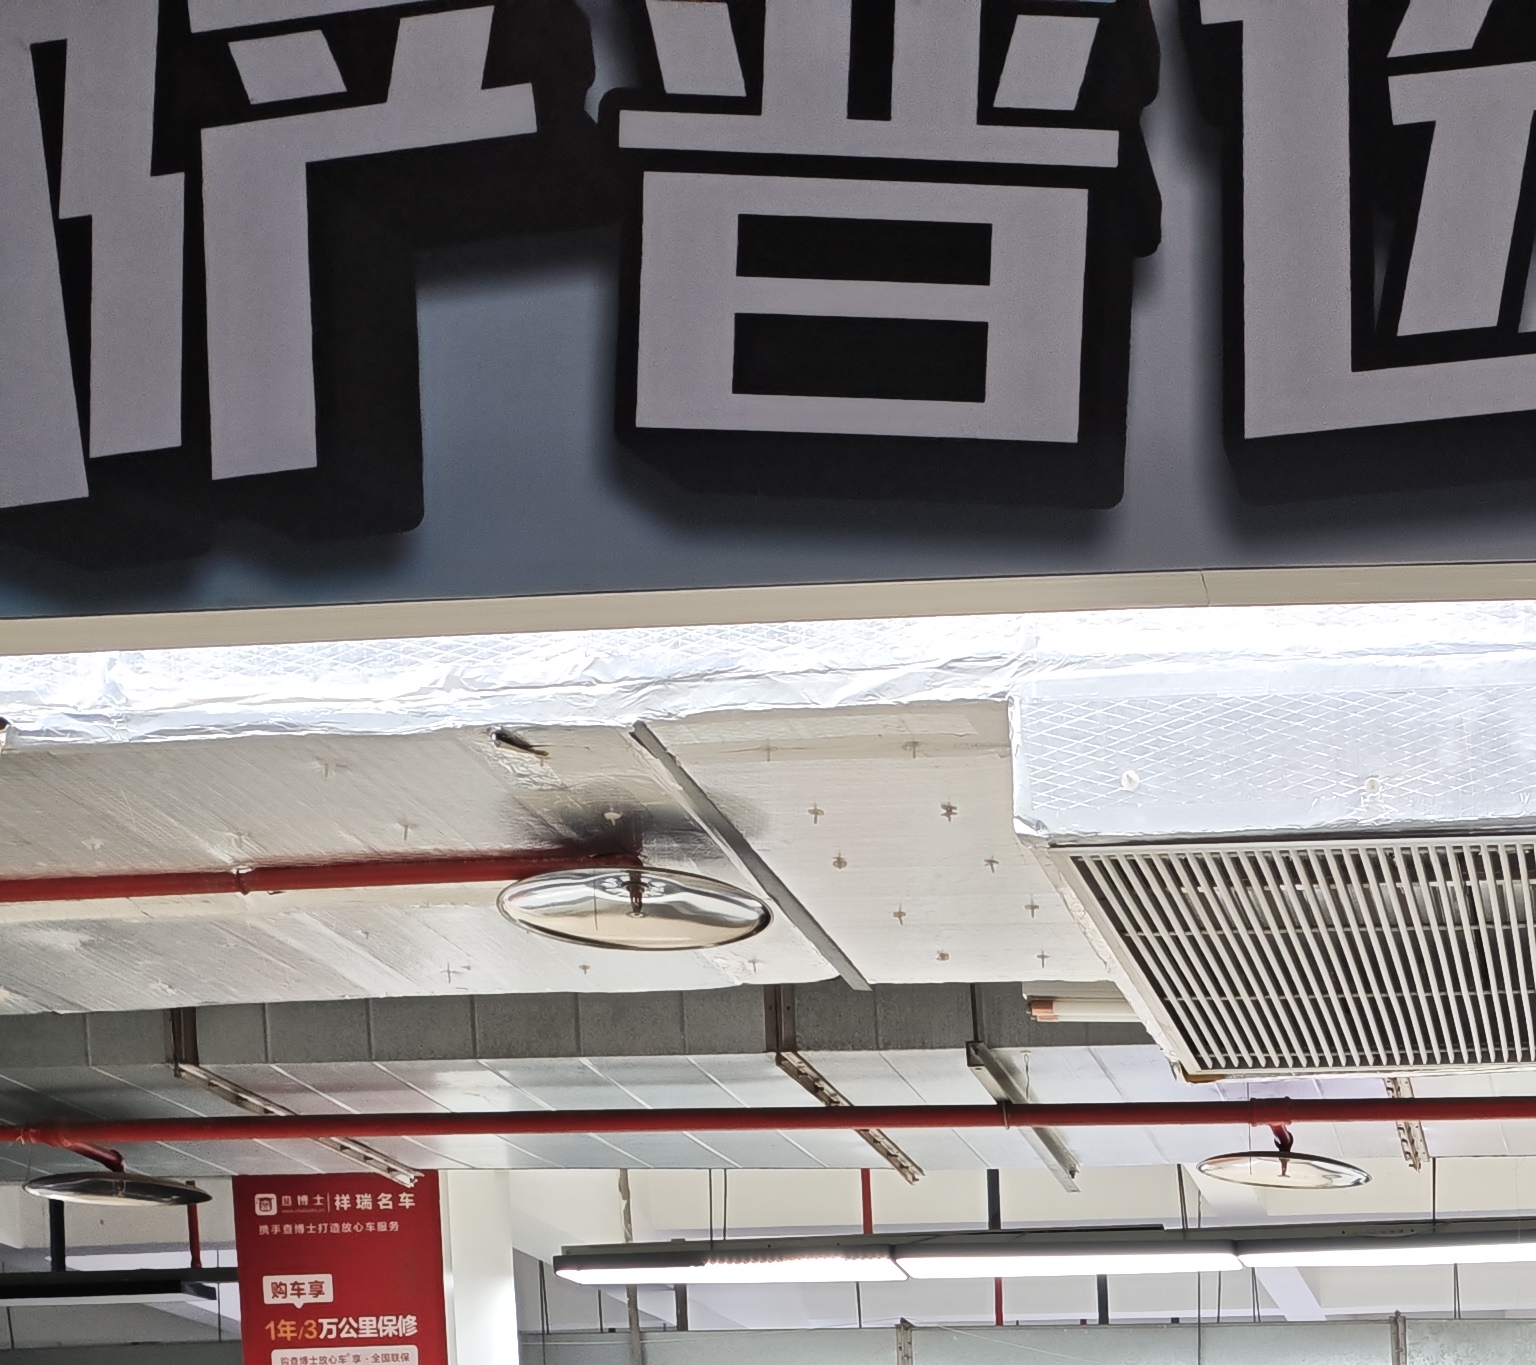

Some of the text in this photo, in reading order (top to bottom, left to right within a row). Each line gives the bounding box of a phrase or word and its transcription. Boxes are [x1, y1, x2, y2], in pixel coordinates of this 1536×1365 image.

[334, 1192, 416, 1211] 祥瑞名车
[258, 1221, 400, 1236] 携手查博士打造放心车服务
[270, 1280, 326, 1299] 购车享
[264, 1314, 419, 1341] 1年/3万公里保修
